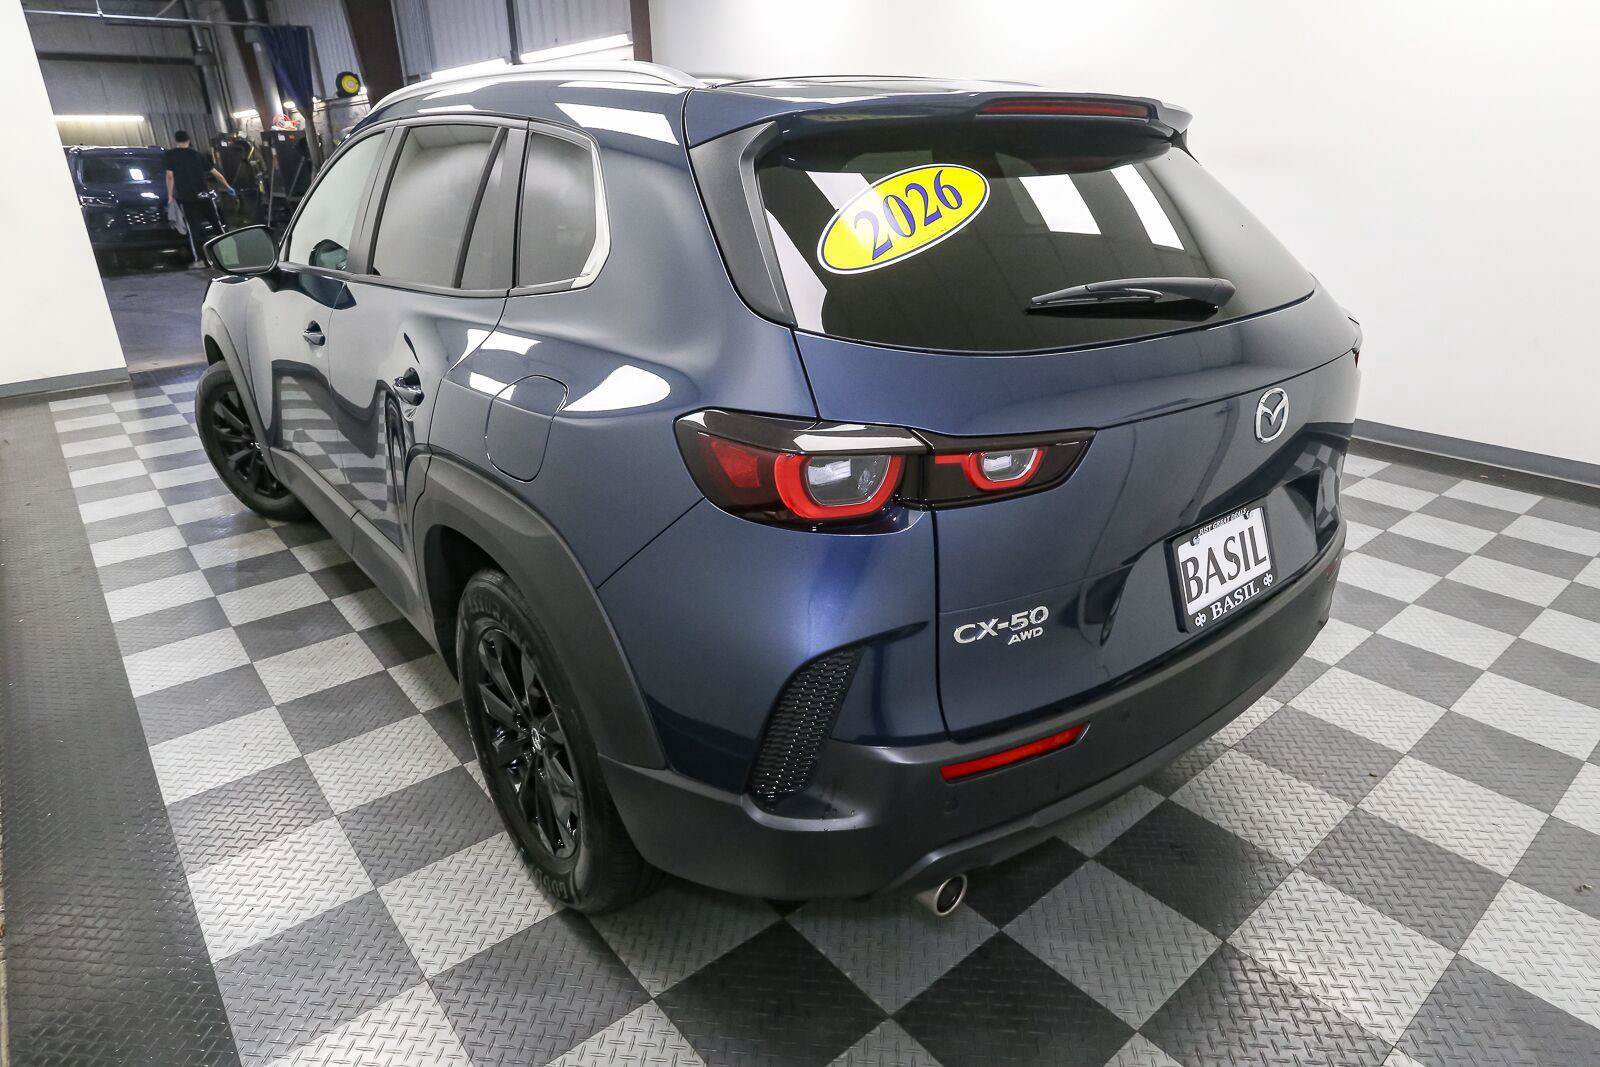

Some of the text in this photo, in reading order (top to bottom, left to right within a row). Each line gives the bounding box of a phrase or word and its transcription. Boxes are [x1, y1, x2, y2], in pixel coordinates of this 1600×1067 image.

[854, 169, 963, 260] 2026
[1181, 526, 1267, 605] BASIL
[1209, 580, 1260, 620] BASIL
[953, 605, 1049, 644] CX-50
[1007, 626, 1044, 645] AWD
